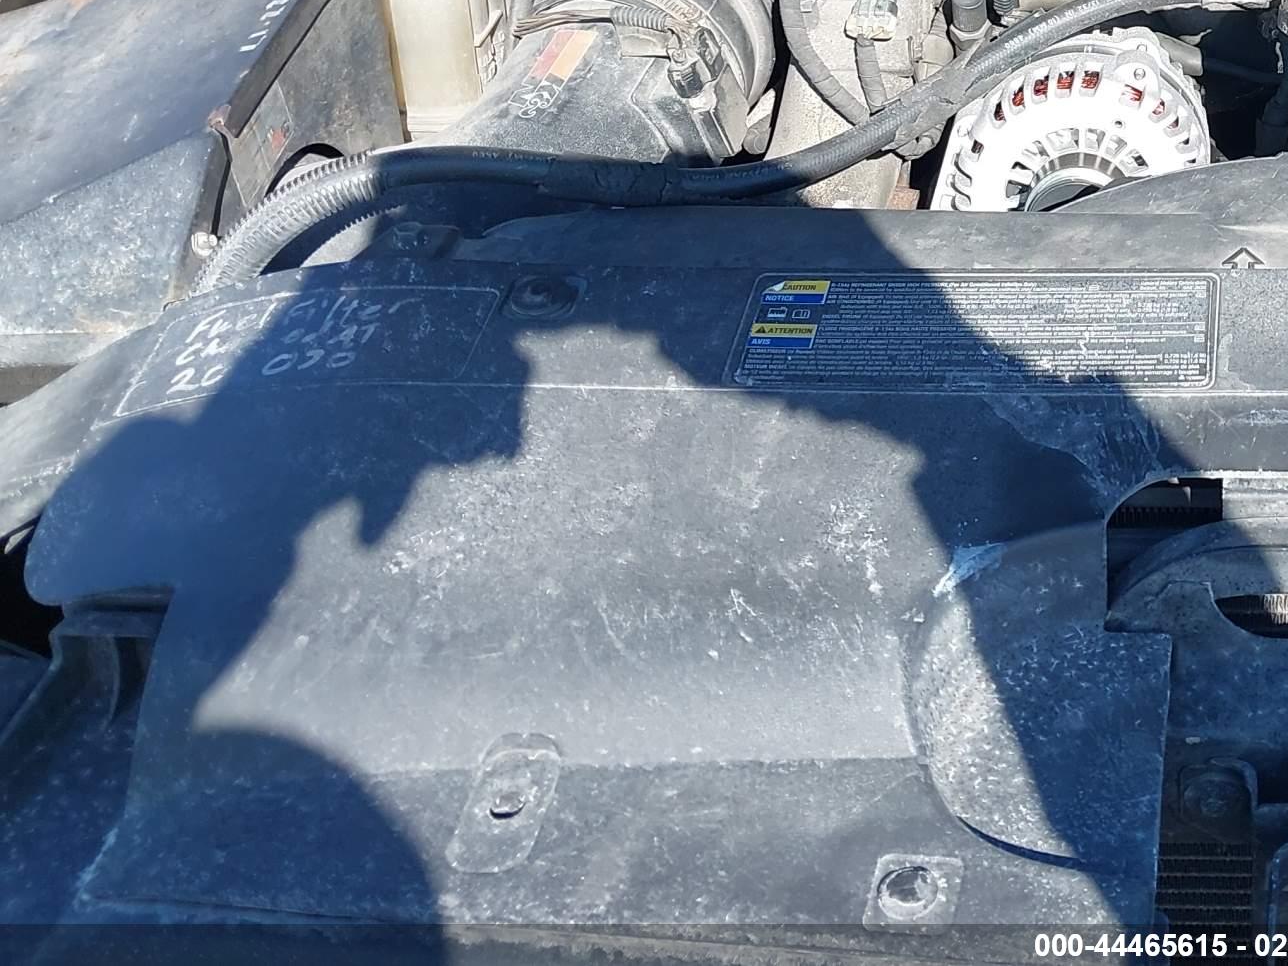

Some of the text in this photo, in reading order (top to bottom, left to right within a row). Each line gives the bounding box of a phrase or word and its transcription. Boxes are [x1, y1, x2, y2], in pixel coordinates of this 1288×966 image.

[783, 283, 817, 291] CAUTION
[185, 295, 423, 344] Fuel Filter
